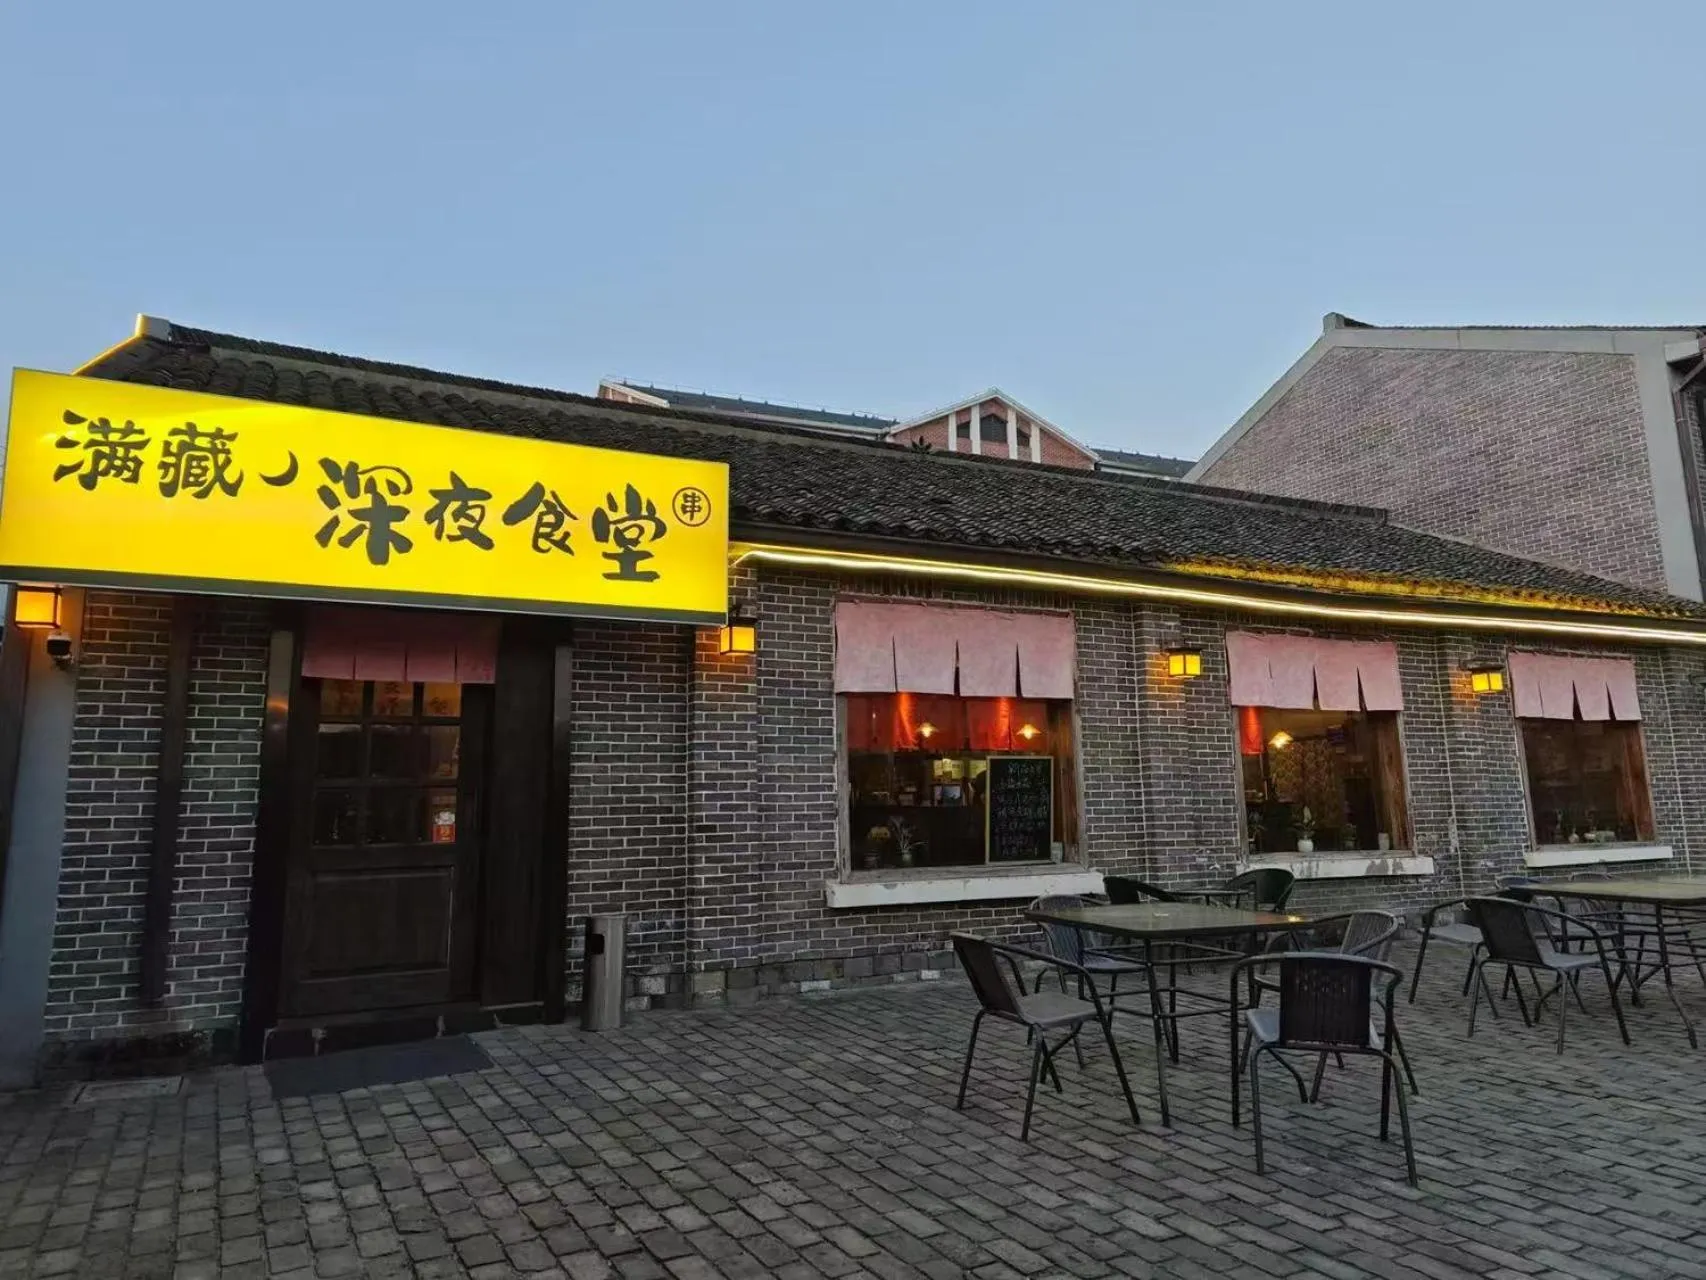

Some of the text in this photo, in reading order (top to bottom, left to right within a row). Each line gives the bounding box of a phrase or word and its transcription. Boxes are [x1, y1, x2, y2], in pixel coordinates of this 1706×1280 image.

[54, 409, 668, 583] 满藏 深夜食堂
[679, 490, 704, 522] 串
